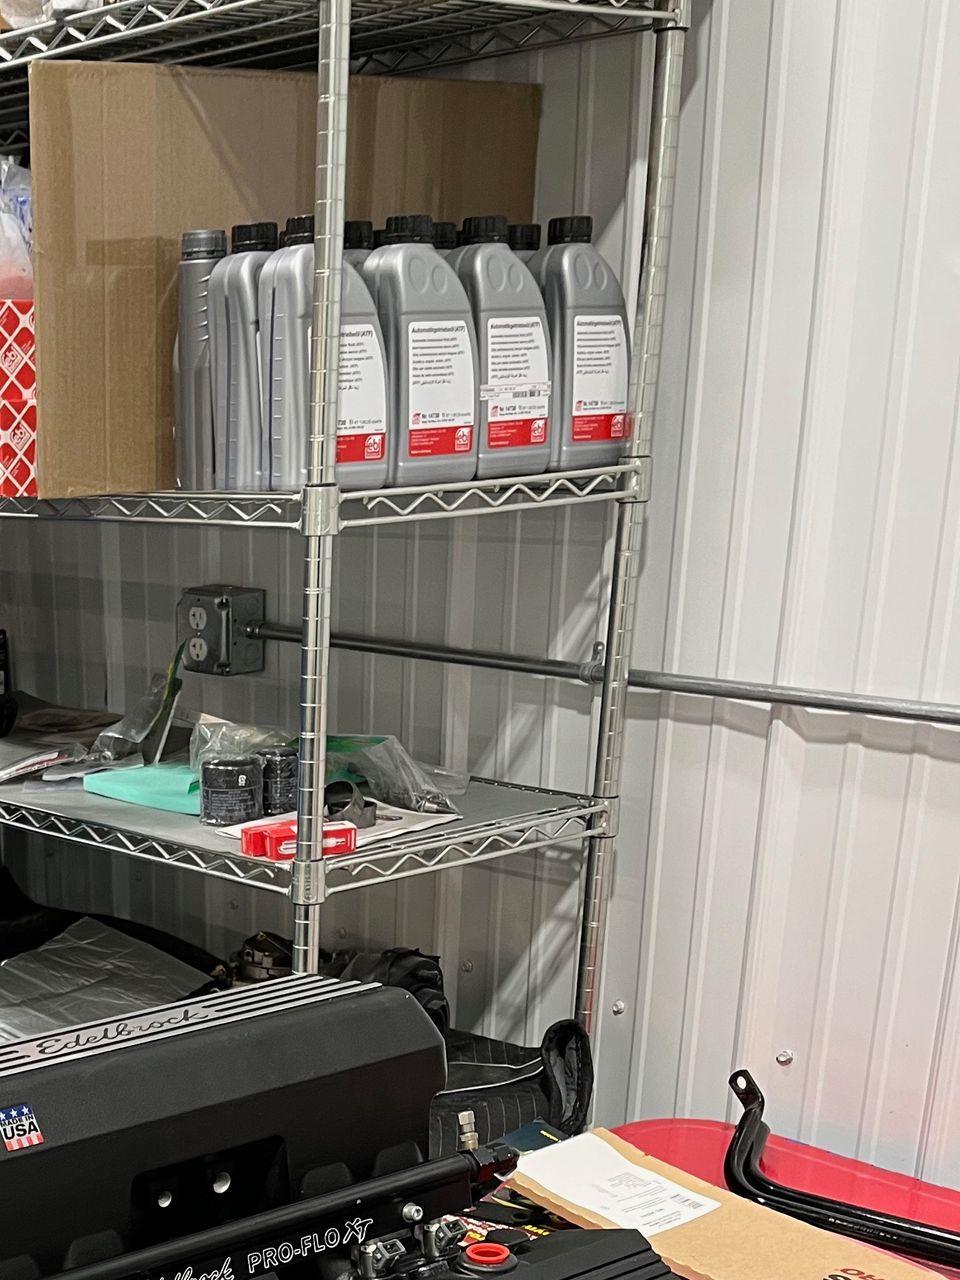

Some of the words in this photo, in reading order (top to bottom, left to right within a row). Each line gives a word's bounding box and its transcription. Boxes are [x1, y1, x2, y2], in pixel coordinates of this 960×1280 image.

[36, 1009, 209, 1054] Edelbrock
[0, 1117, 24, 1127] MADE
[3, 1121, 39, 1140] USA
[247, 1227, 340, 1274] PRO-FLO
[343, 1217, 373, 1244] XT
